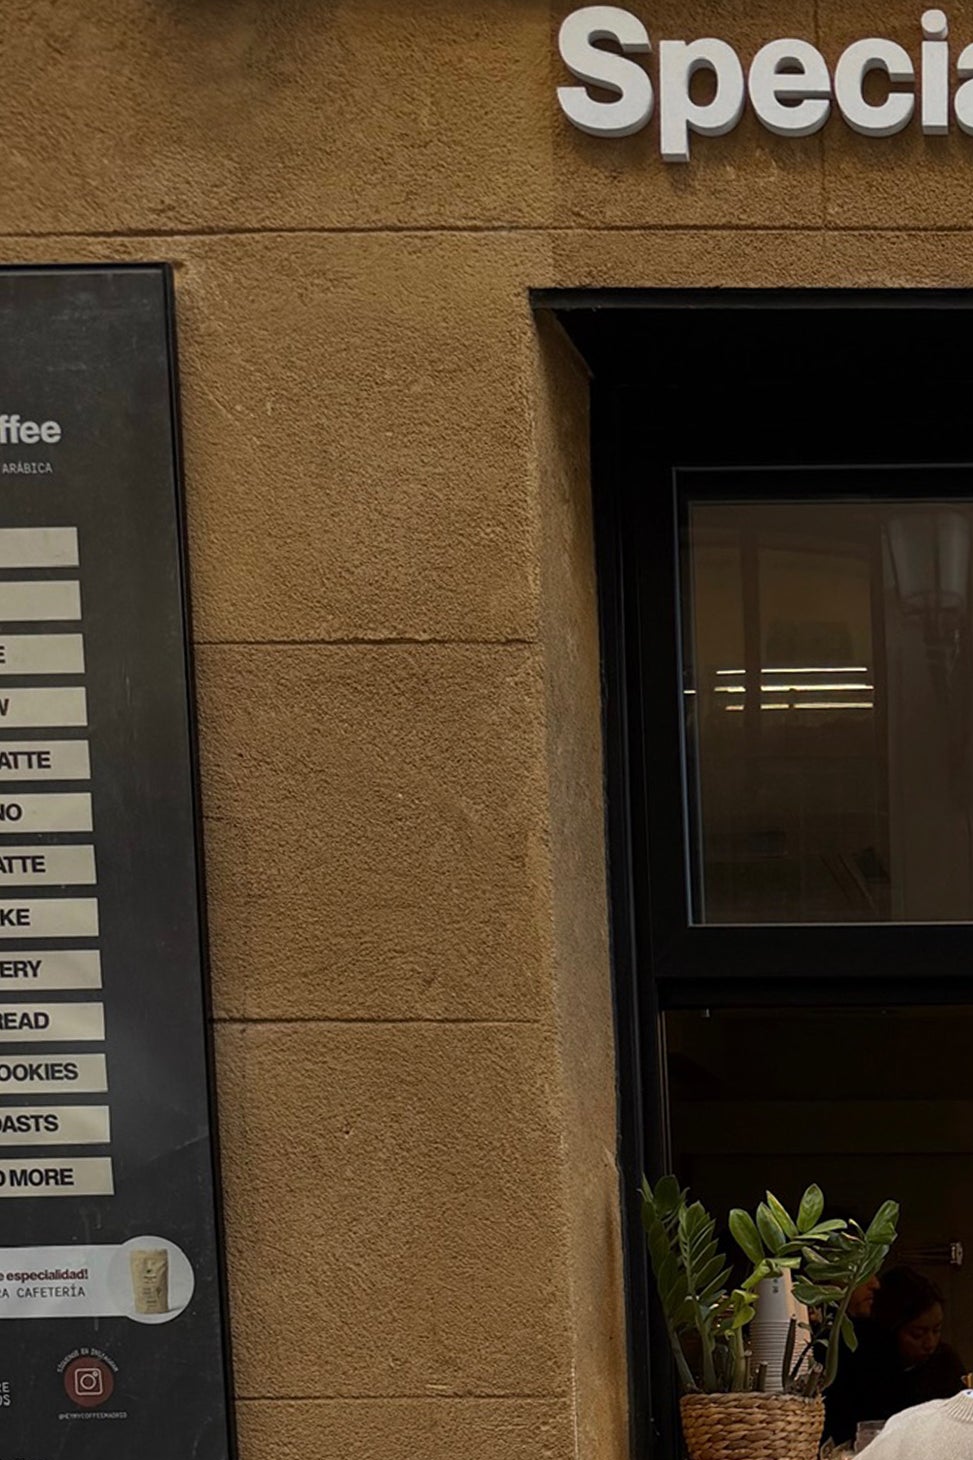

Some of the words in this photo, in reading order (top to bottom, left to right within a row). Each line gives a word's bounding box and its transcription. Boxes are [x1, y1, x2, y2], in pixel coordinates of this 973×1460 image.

[0, 414, 61, 444] ffee
[2, 461, 53, 474] ARÁBICA
[0, 960, 41, 978] ERY
[0, 1012, 49, 1030] EAD
[0, 1114, 59, 1133] ASTS
[9, 1168, 74, 1187] MORE
[6, 1268, 88, 1283] especialidad!
[17, 1284, 85, 1298] CAFETERÍA
